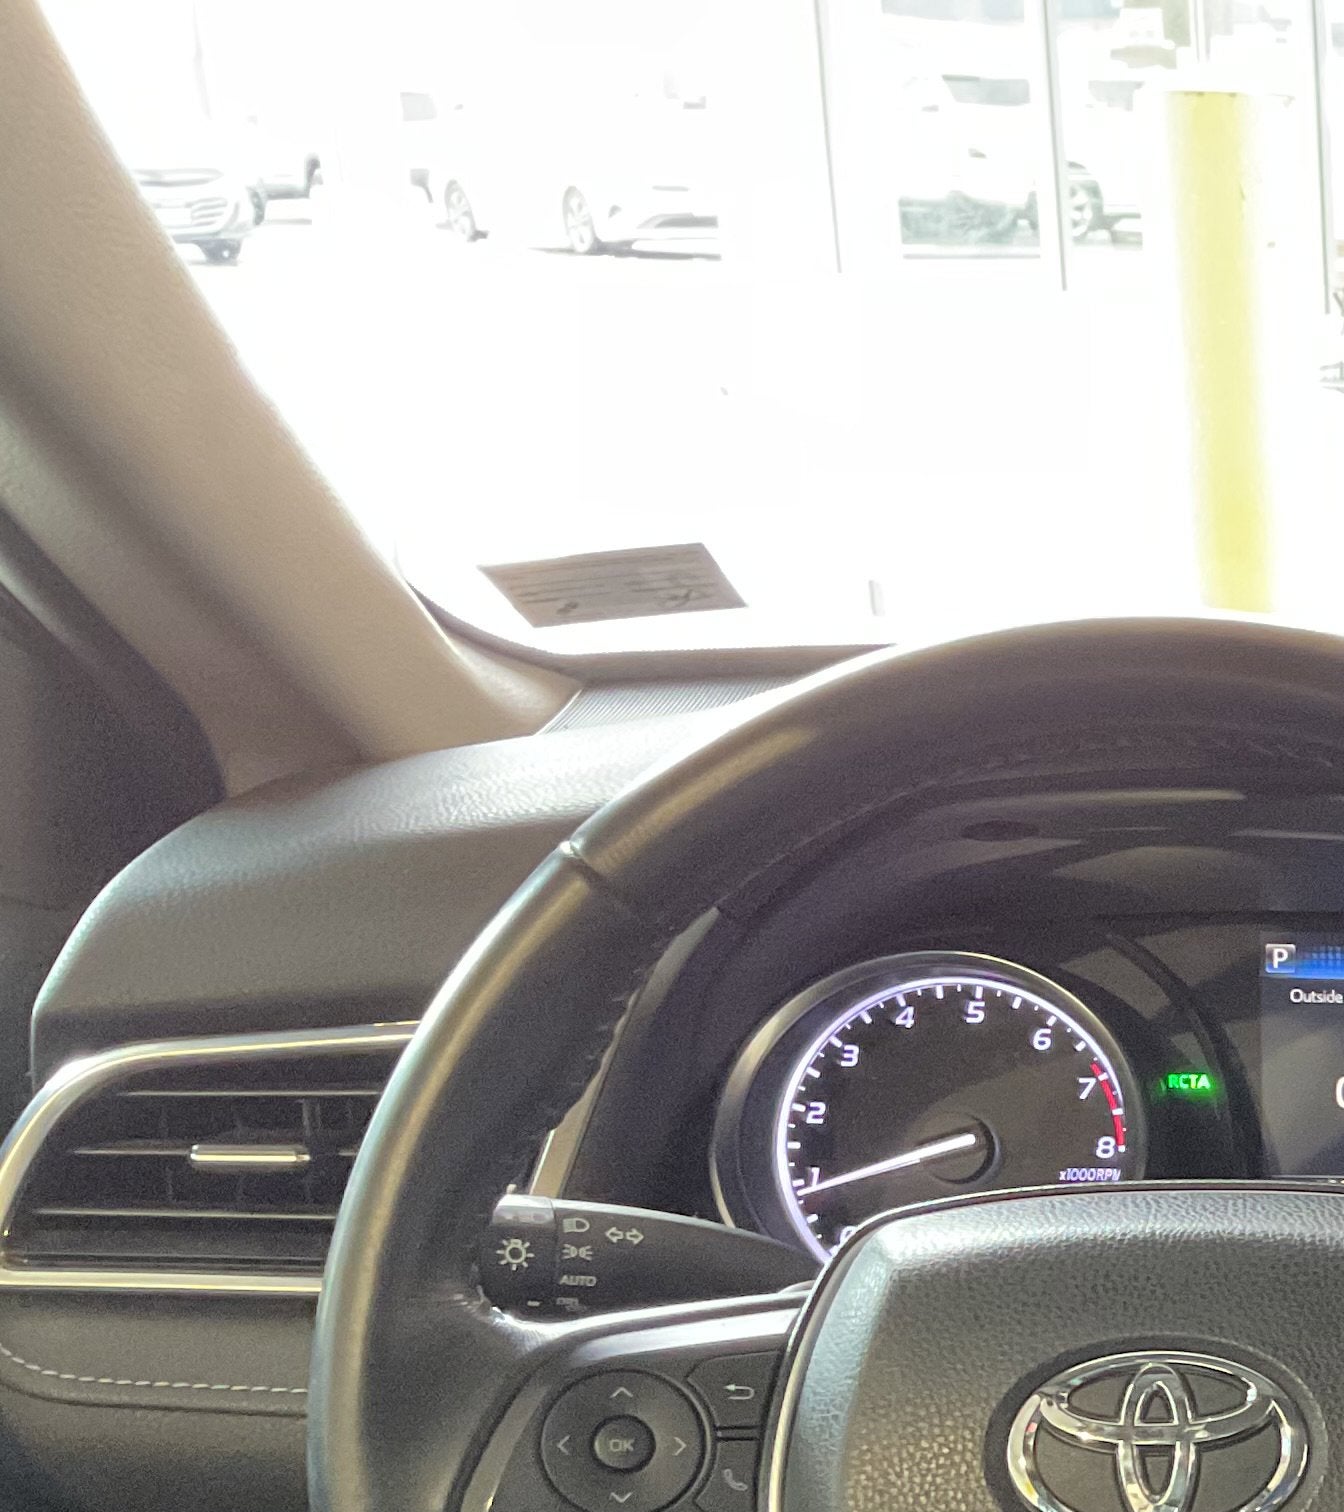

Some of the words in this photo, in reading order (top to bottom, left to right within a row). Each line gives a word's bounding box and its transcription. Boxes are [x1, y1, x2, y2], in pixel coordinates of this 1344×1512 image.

[1272, 948, 1289, 969] P
[1289, 988, 1344, 1005] Outside
[895, 1006, 915, 1029] 4
[964, 1001, 986, 1024] 5
[1033, 1027, 1052, 1051] 6
[839, 1045, 860, 1068] 3
[1078, 1077, 1097, 1100] 7
[1166, 1073, 1212, 1090] RCTA
[805, 1101, 827, 1125] 2
[1095, 1136, 1116, 1159] 8
[559, 1274, 597, 1288] AUTO
[609, 1436, 635, 1454] OK
